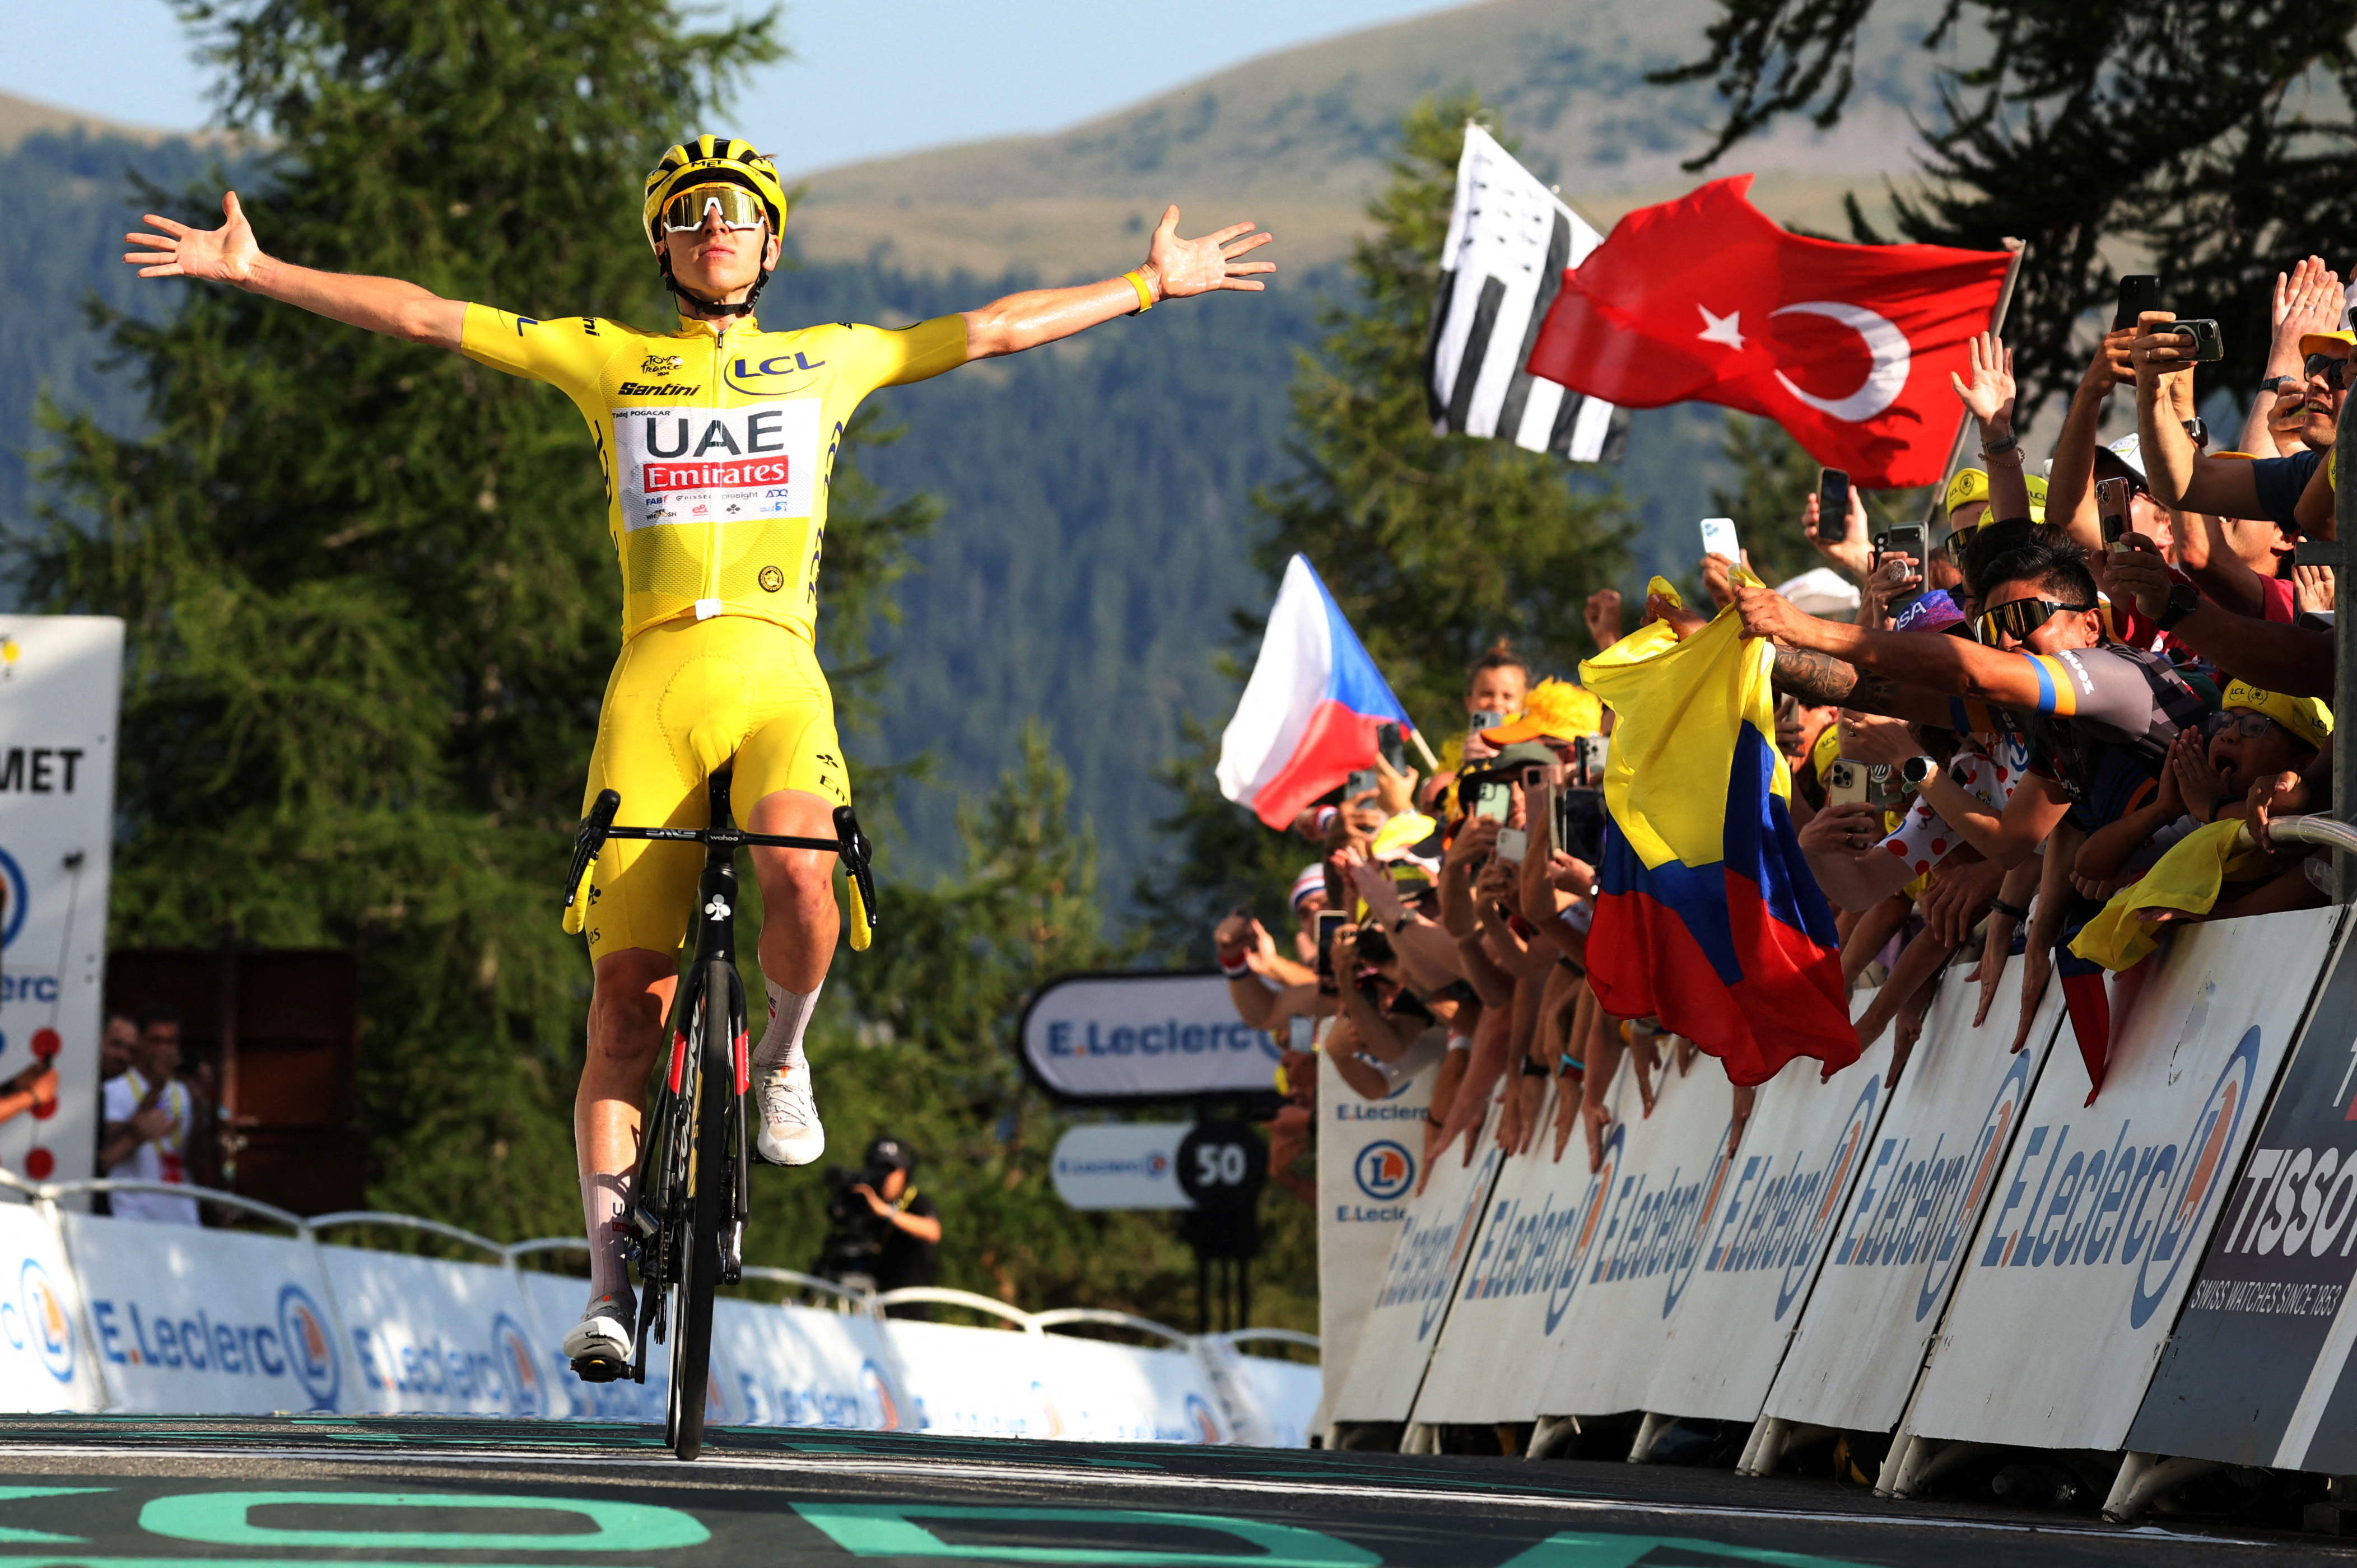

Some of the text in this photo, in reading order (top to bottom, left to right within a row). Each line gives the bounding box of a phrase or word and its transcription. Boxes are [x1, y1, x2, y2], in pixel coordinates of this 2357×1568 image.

[691, 158, 724, 168] MET
[734, 352, 826, 378] LCL
[618, 382, 701, 396] Santini
[646, 410, 785, 458] UAE
[648, 463, 785, 488] Emirates
[646, 497, 663, 506] FAB
[721, 491, 758, 500] presight
[1047, 1019, 1251, 1058] E.Leclerc
[1196, 1143, 1246, 1186] 50
[1704, 1150, 1822, 1272] E.Leclerc
[1834, 1133, 1965, 1267] E.Leclerc
[1981, 1119, 2177, 1267] E.Leclerc
[2224, 1147, 2357, 1258] TISSO
[2191, 1279, 2342, 1317] SWISS WATCHES SINCE 1853
[92, 1299, 286, 1378] E.Leclerc
